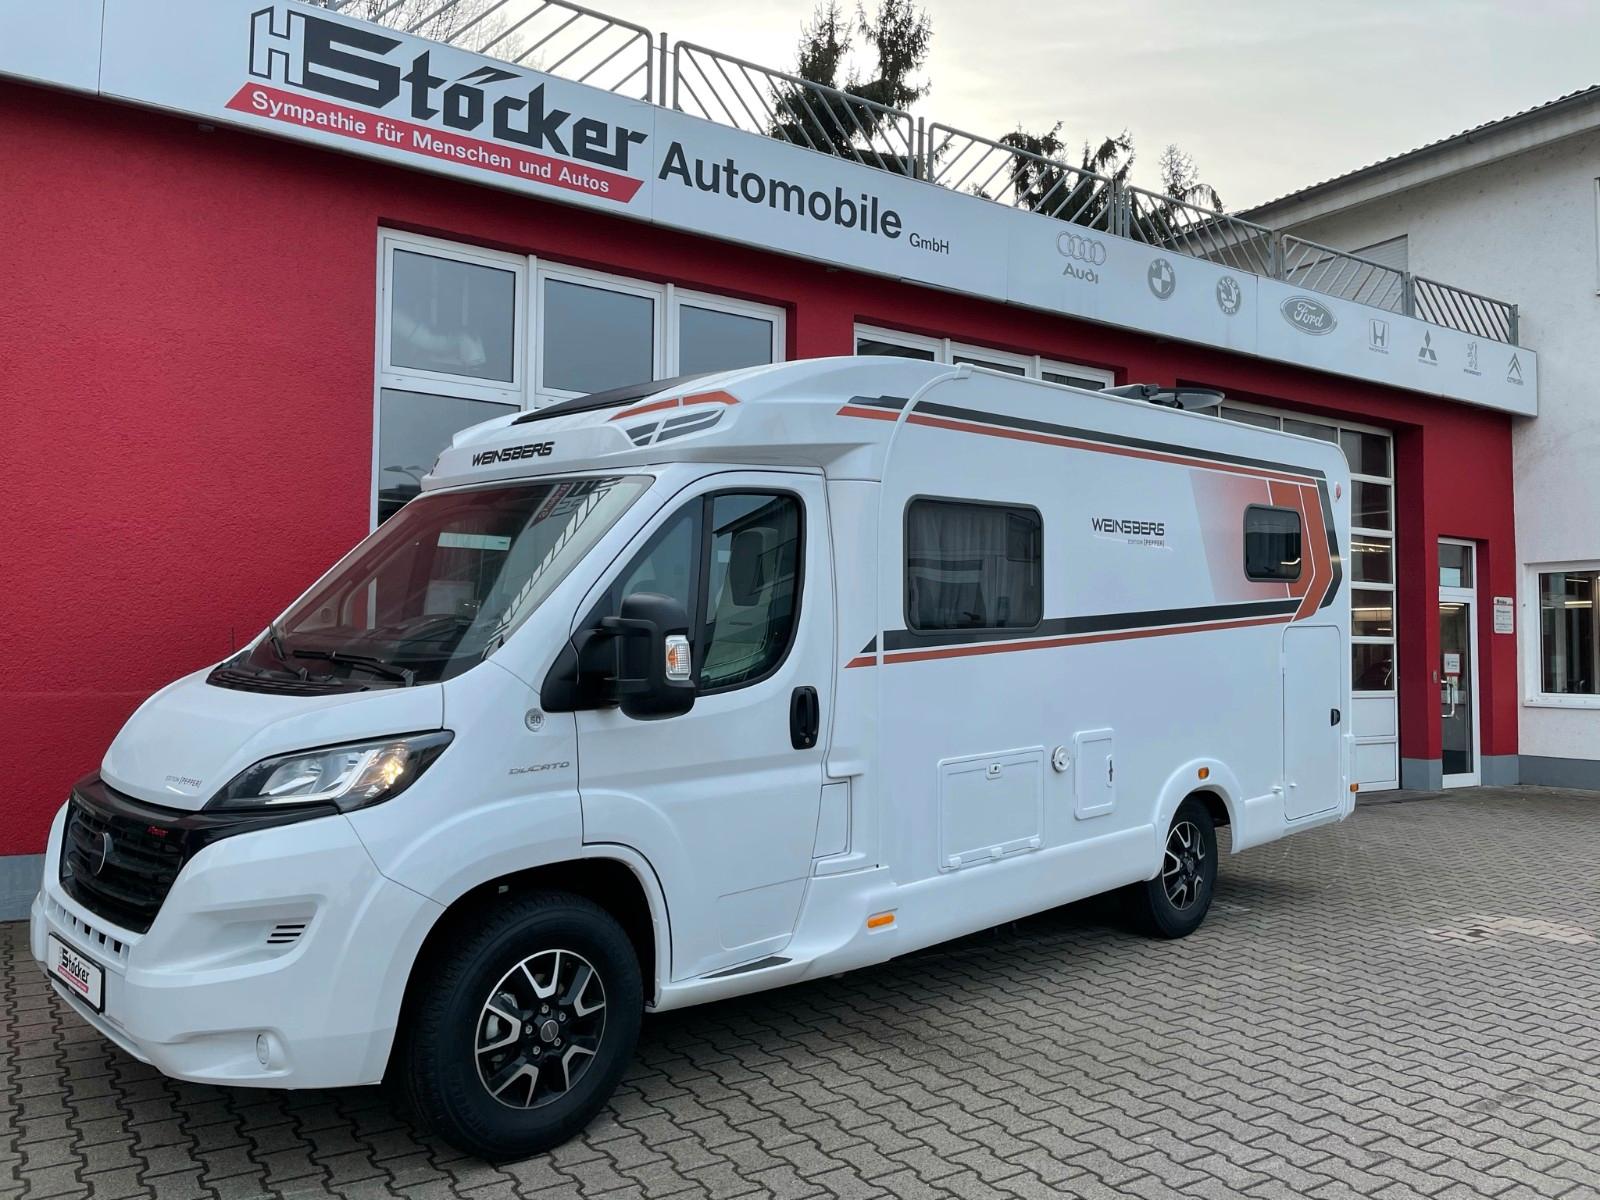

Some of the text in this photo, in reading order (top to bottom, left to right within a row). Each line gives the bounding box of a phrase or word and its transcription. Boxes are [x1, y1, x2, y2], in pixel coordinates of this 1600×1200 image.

[252, 91, 609, 193] Sympathie für Menschen und Autos
[658, 141, 949, 255] Automobile GmbH
[1063, 263, 1099, 284] Audi
[1293, 302, 1324, 328] Ford
[472, 441, 555, 467] WEINSBERG
[1091, 517, 1165, 537] WEINSBERG
[508, 761, 570, 775] DUCATO
